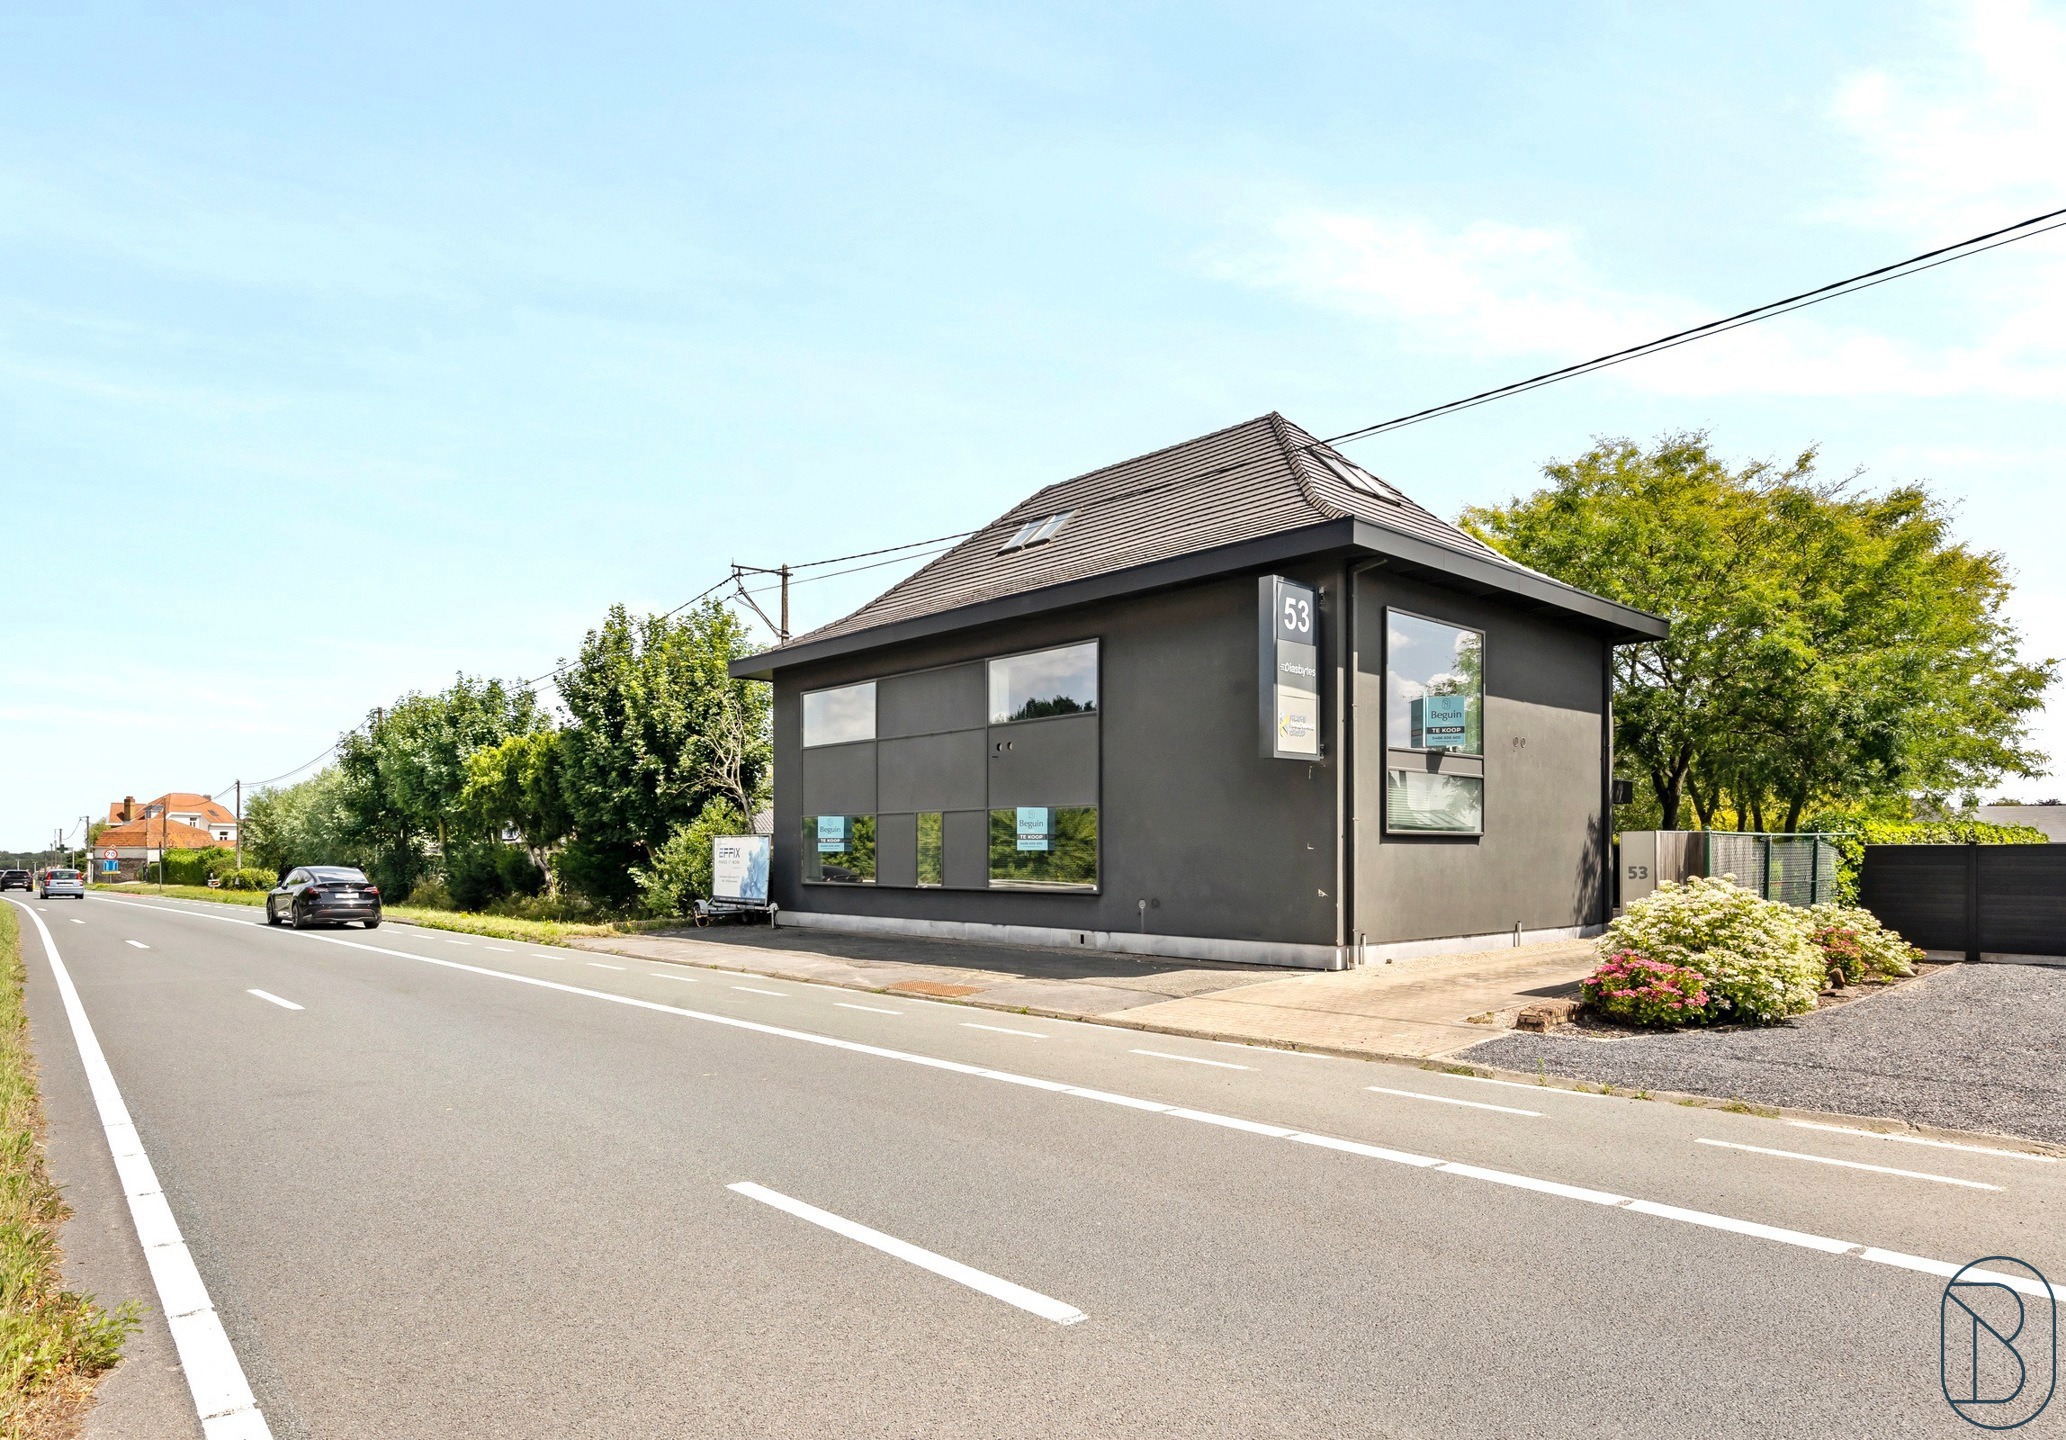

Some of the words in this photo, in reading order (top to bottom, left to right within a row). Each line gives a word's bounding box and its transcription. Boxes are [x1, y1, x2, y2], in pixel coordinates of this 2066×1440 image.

[1284, 597, 1310, 632] 53
[1431, 710, 1462, 721] Beguin
[820, 826, 841, 834] Beguin
[1019, 820, 1044, 829] Beguin
[719, 847, 741, 858] EFFIX
[1628, 866, 1648, 879] 53
